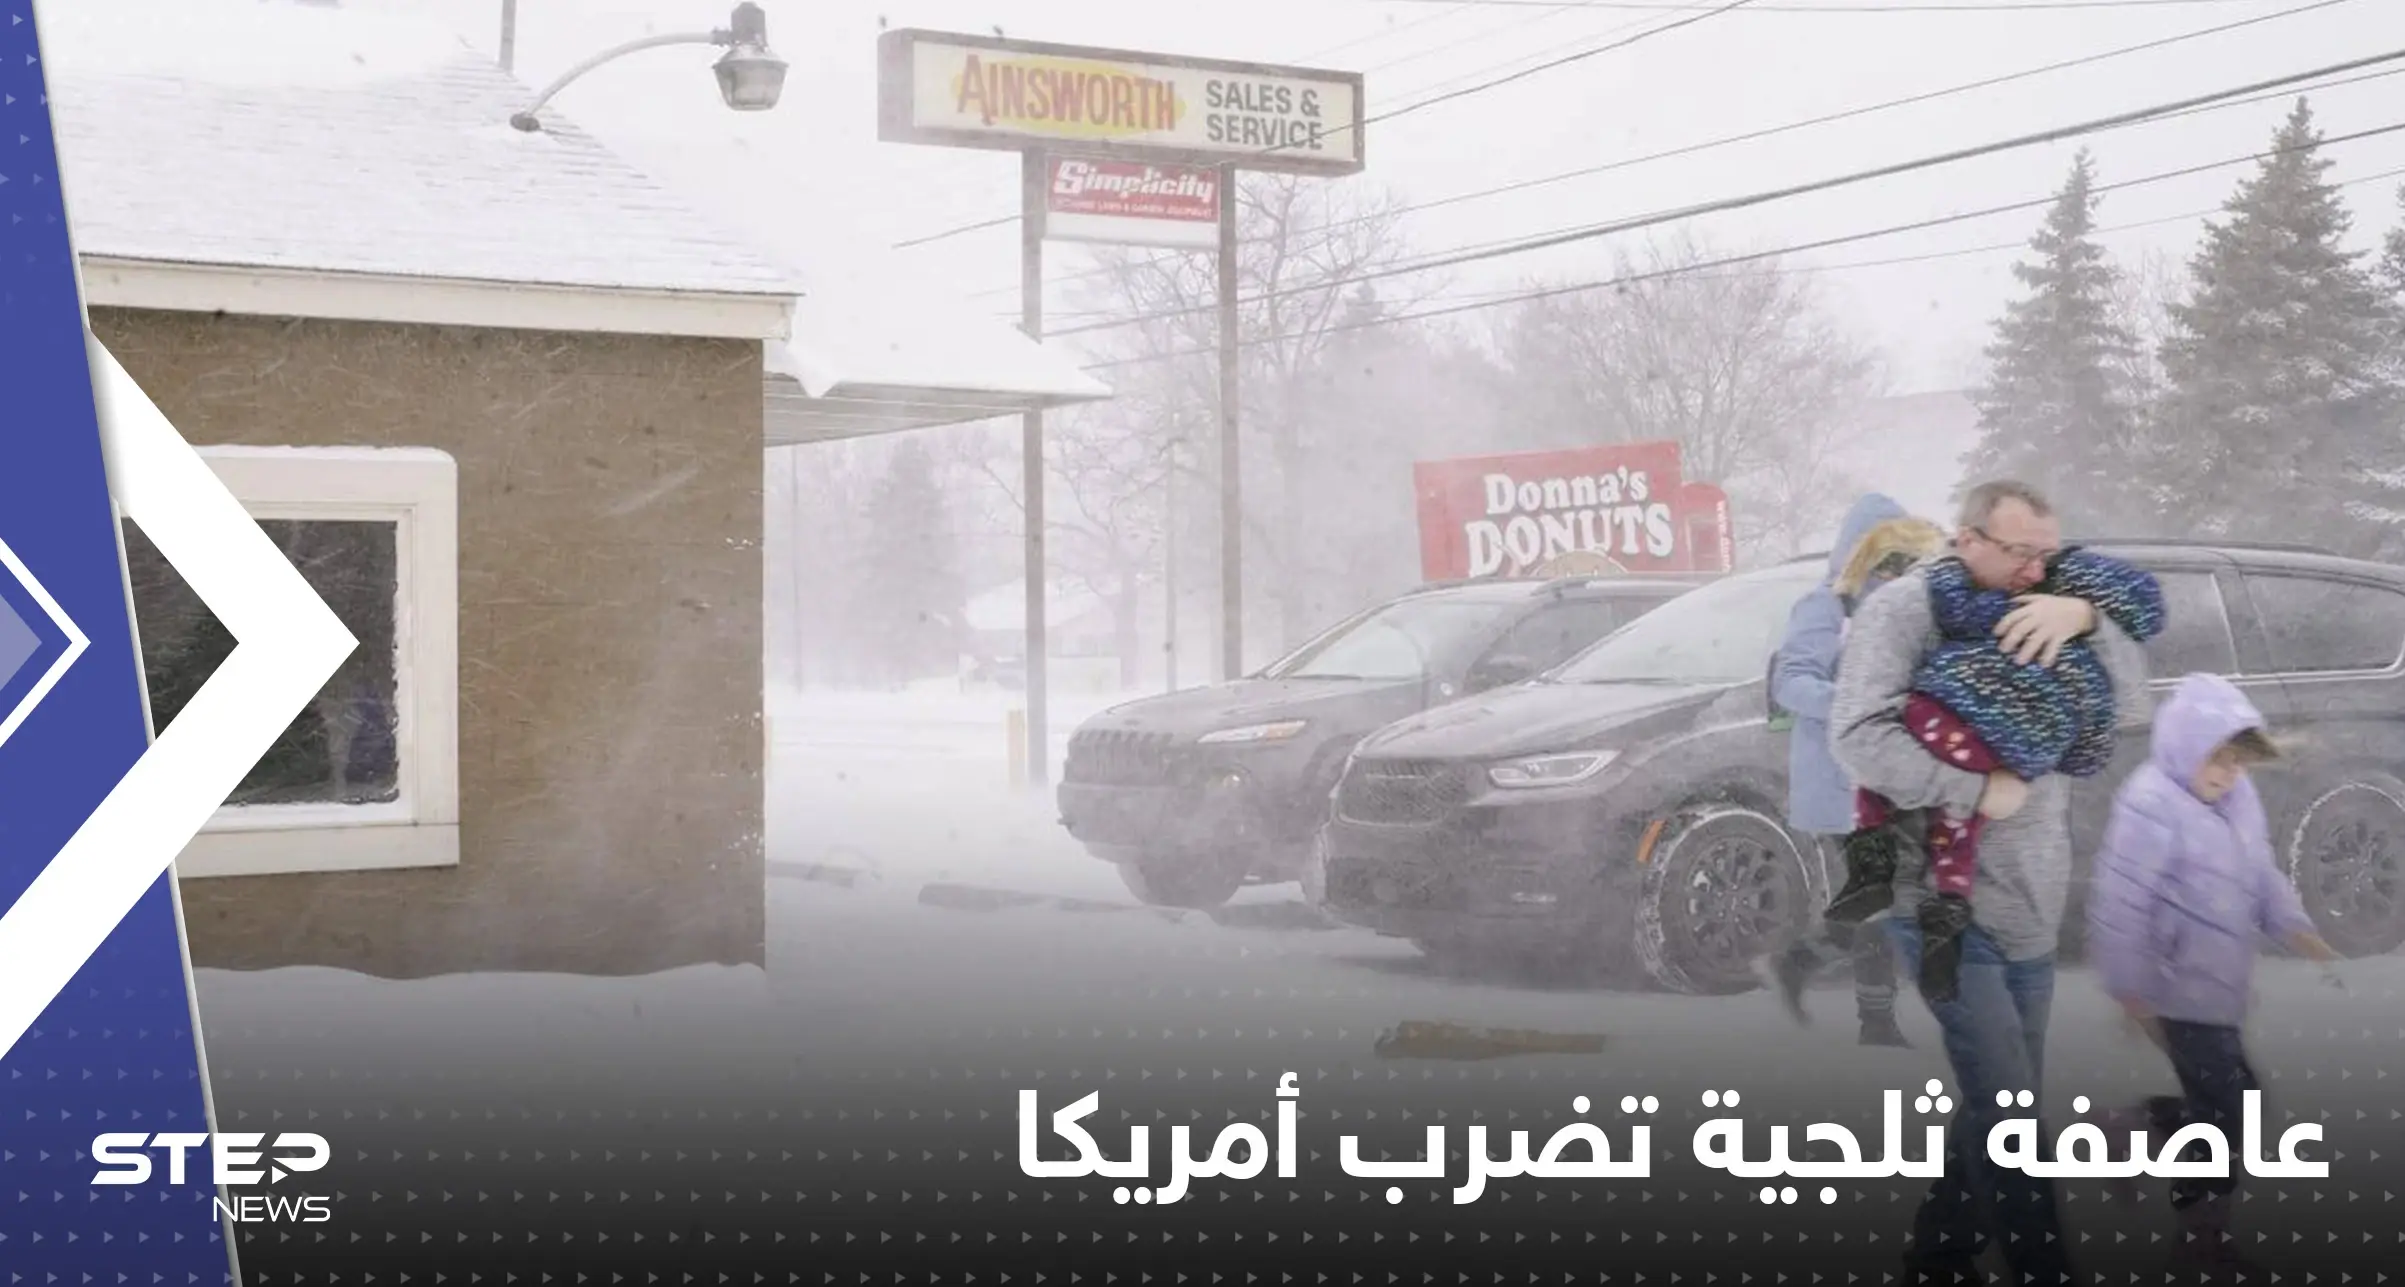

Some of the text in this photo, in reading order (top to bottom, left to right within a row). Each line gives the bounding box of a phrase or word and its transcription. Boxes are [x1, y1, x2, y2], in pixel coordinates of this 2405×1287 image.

[957, 54, 1176, 131] AINSWORTH
[1205, 79, 1321, 118] SALES &
[1206, 114, 1323, 150] SERVICE
[1053, 160, 1214, 204] Simplicity
[1484, 465, 1649, 515] Donna's
[1465, 502, 1674, 578] DONUTS
